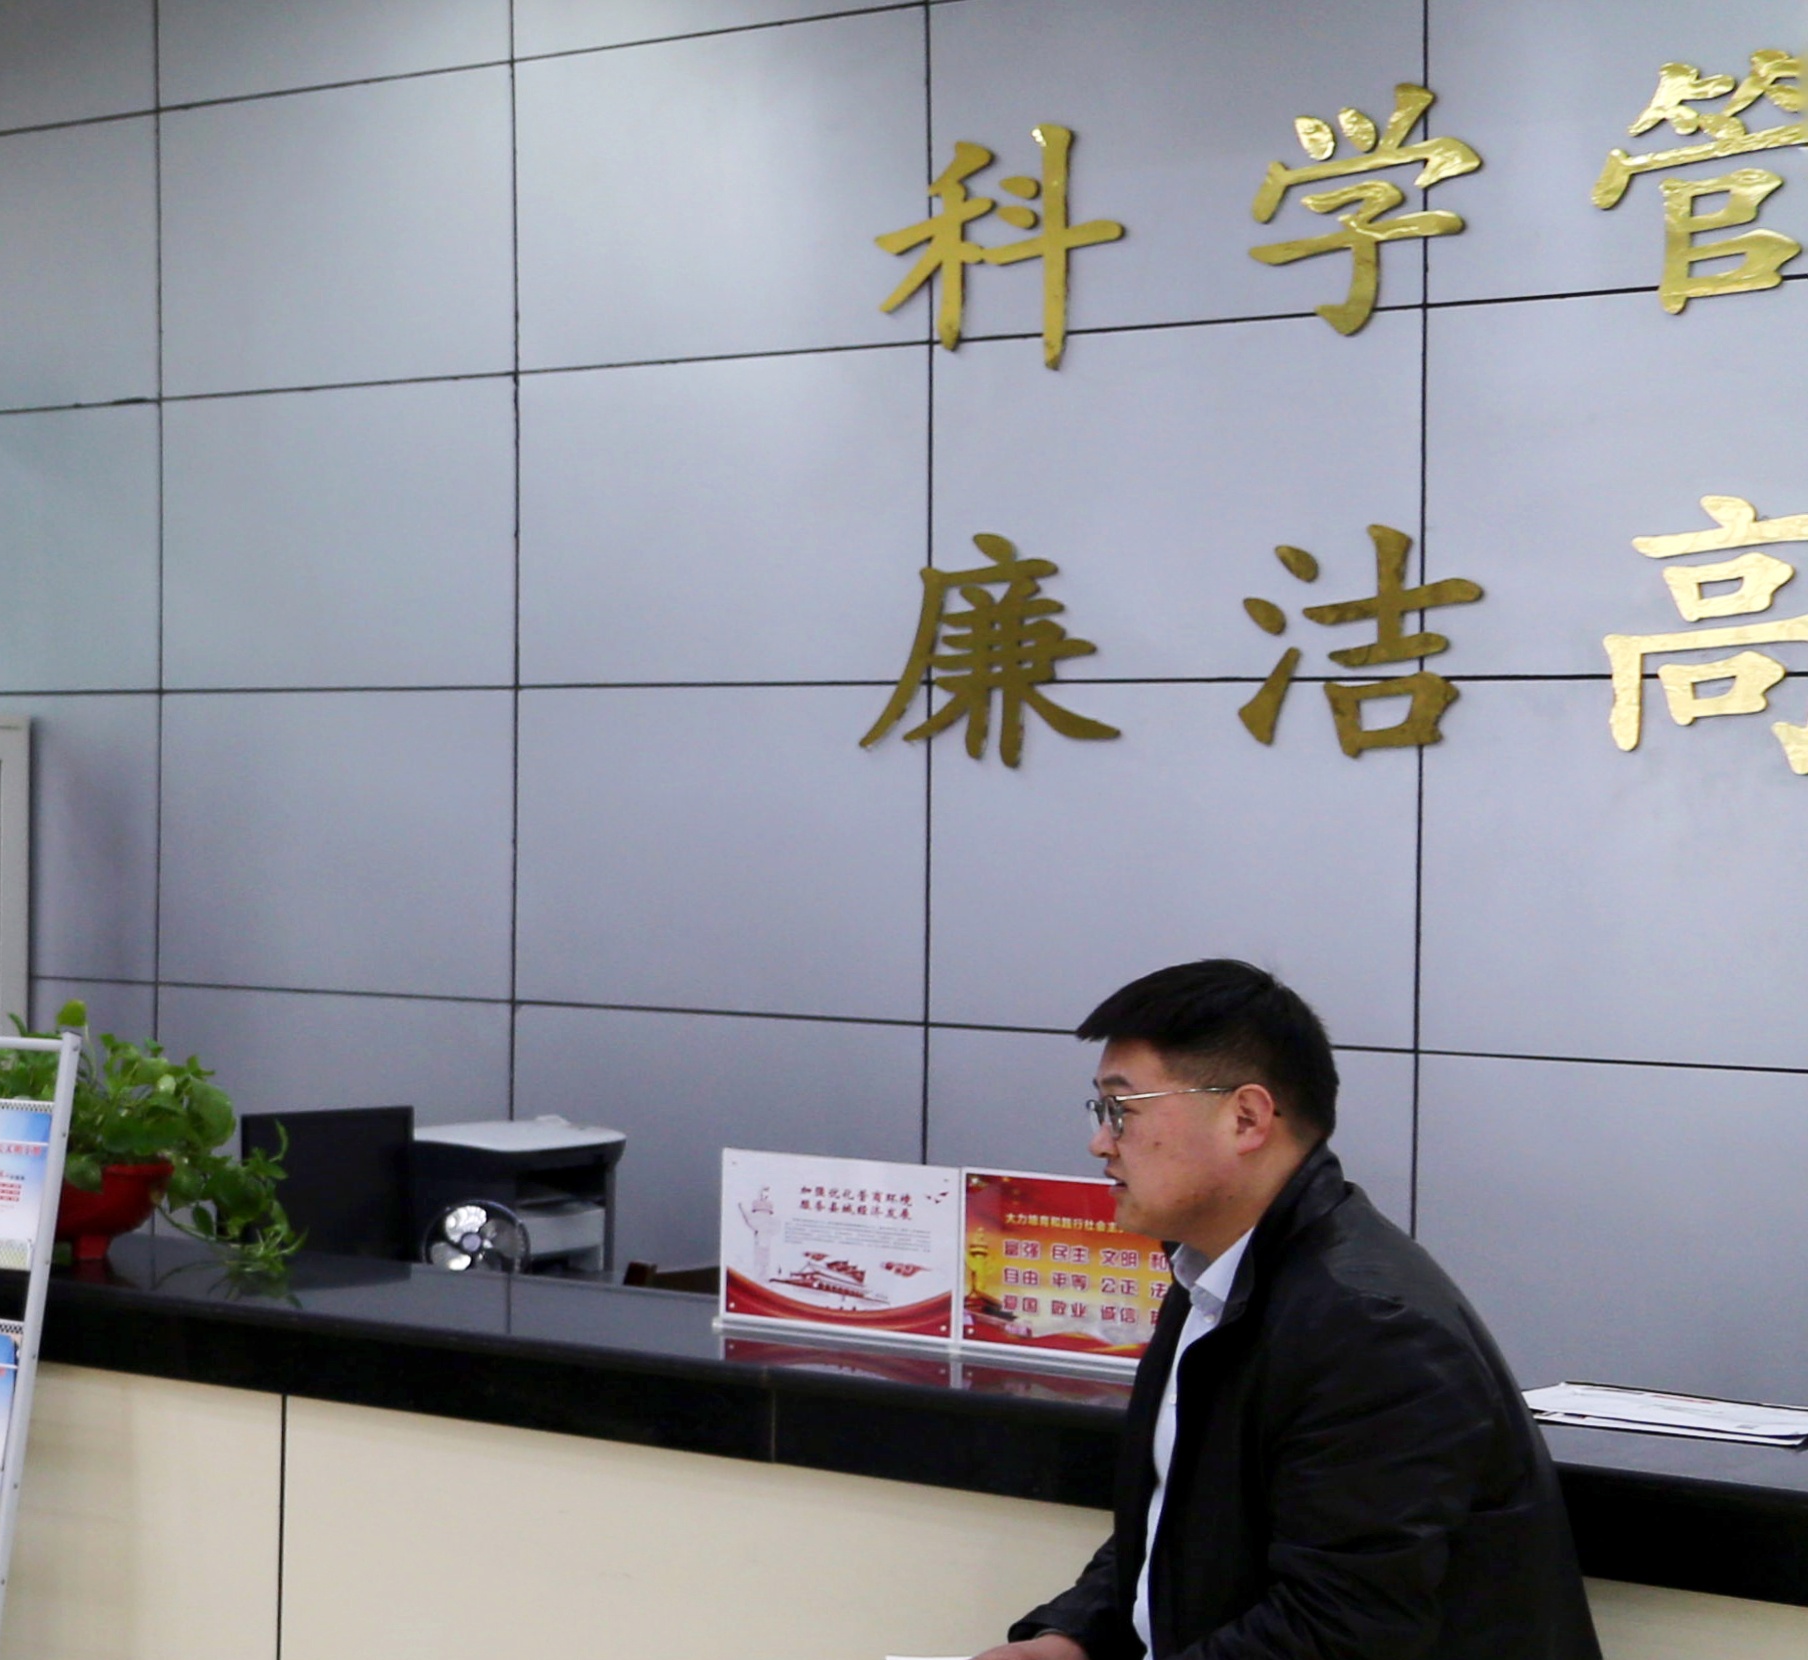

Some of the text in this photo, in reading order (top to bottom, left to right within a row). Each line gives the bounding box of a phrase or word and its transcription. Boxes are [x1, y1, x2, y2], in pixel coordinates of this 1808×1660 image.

[1003, 1240, 1040, 1259] 富强
[1051, 1245, 1089, 1264] 民主
[1101, 1249, 1138, 1267] 文明
[1003, 1268, 1039, 1286] 自由
[1051, 1272, 1089, 1292] 平等
[1101, 1277, 1138, 1295] 公正
[1002, 1295, 1039, 1313] 爱国
[1050, 1300, 1087, 1318] 敬业
[1101, 1306, 1138, 1323] 诚信
